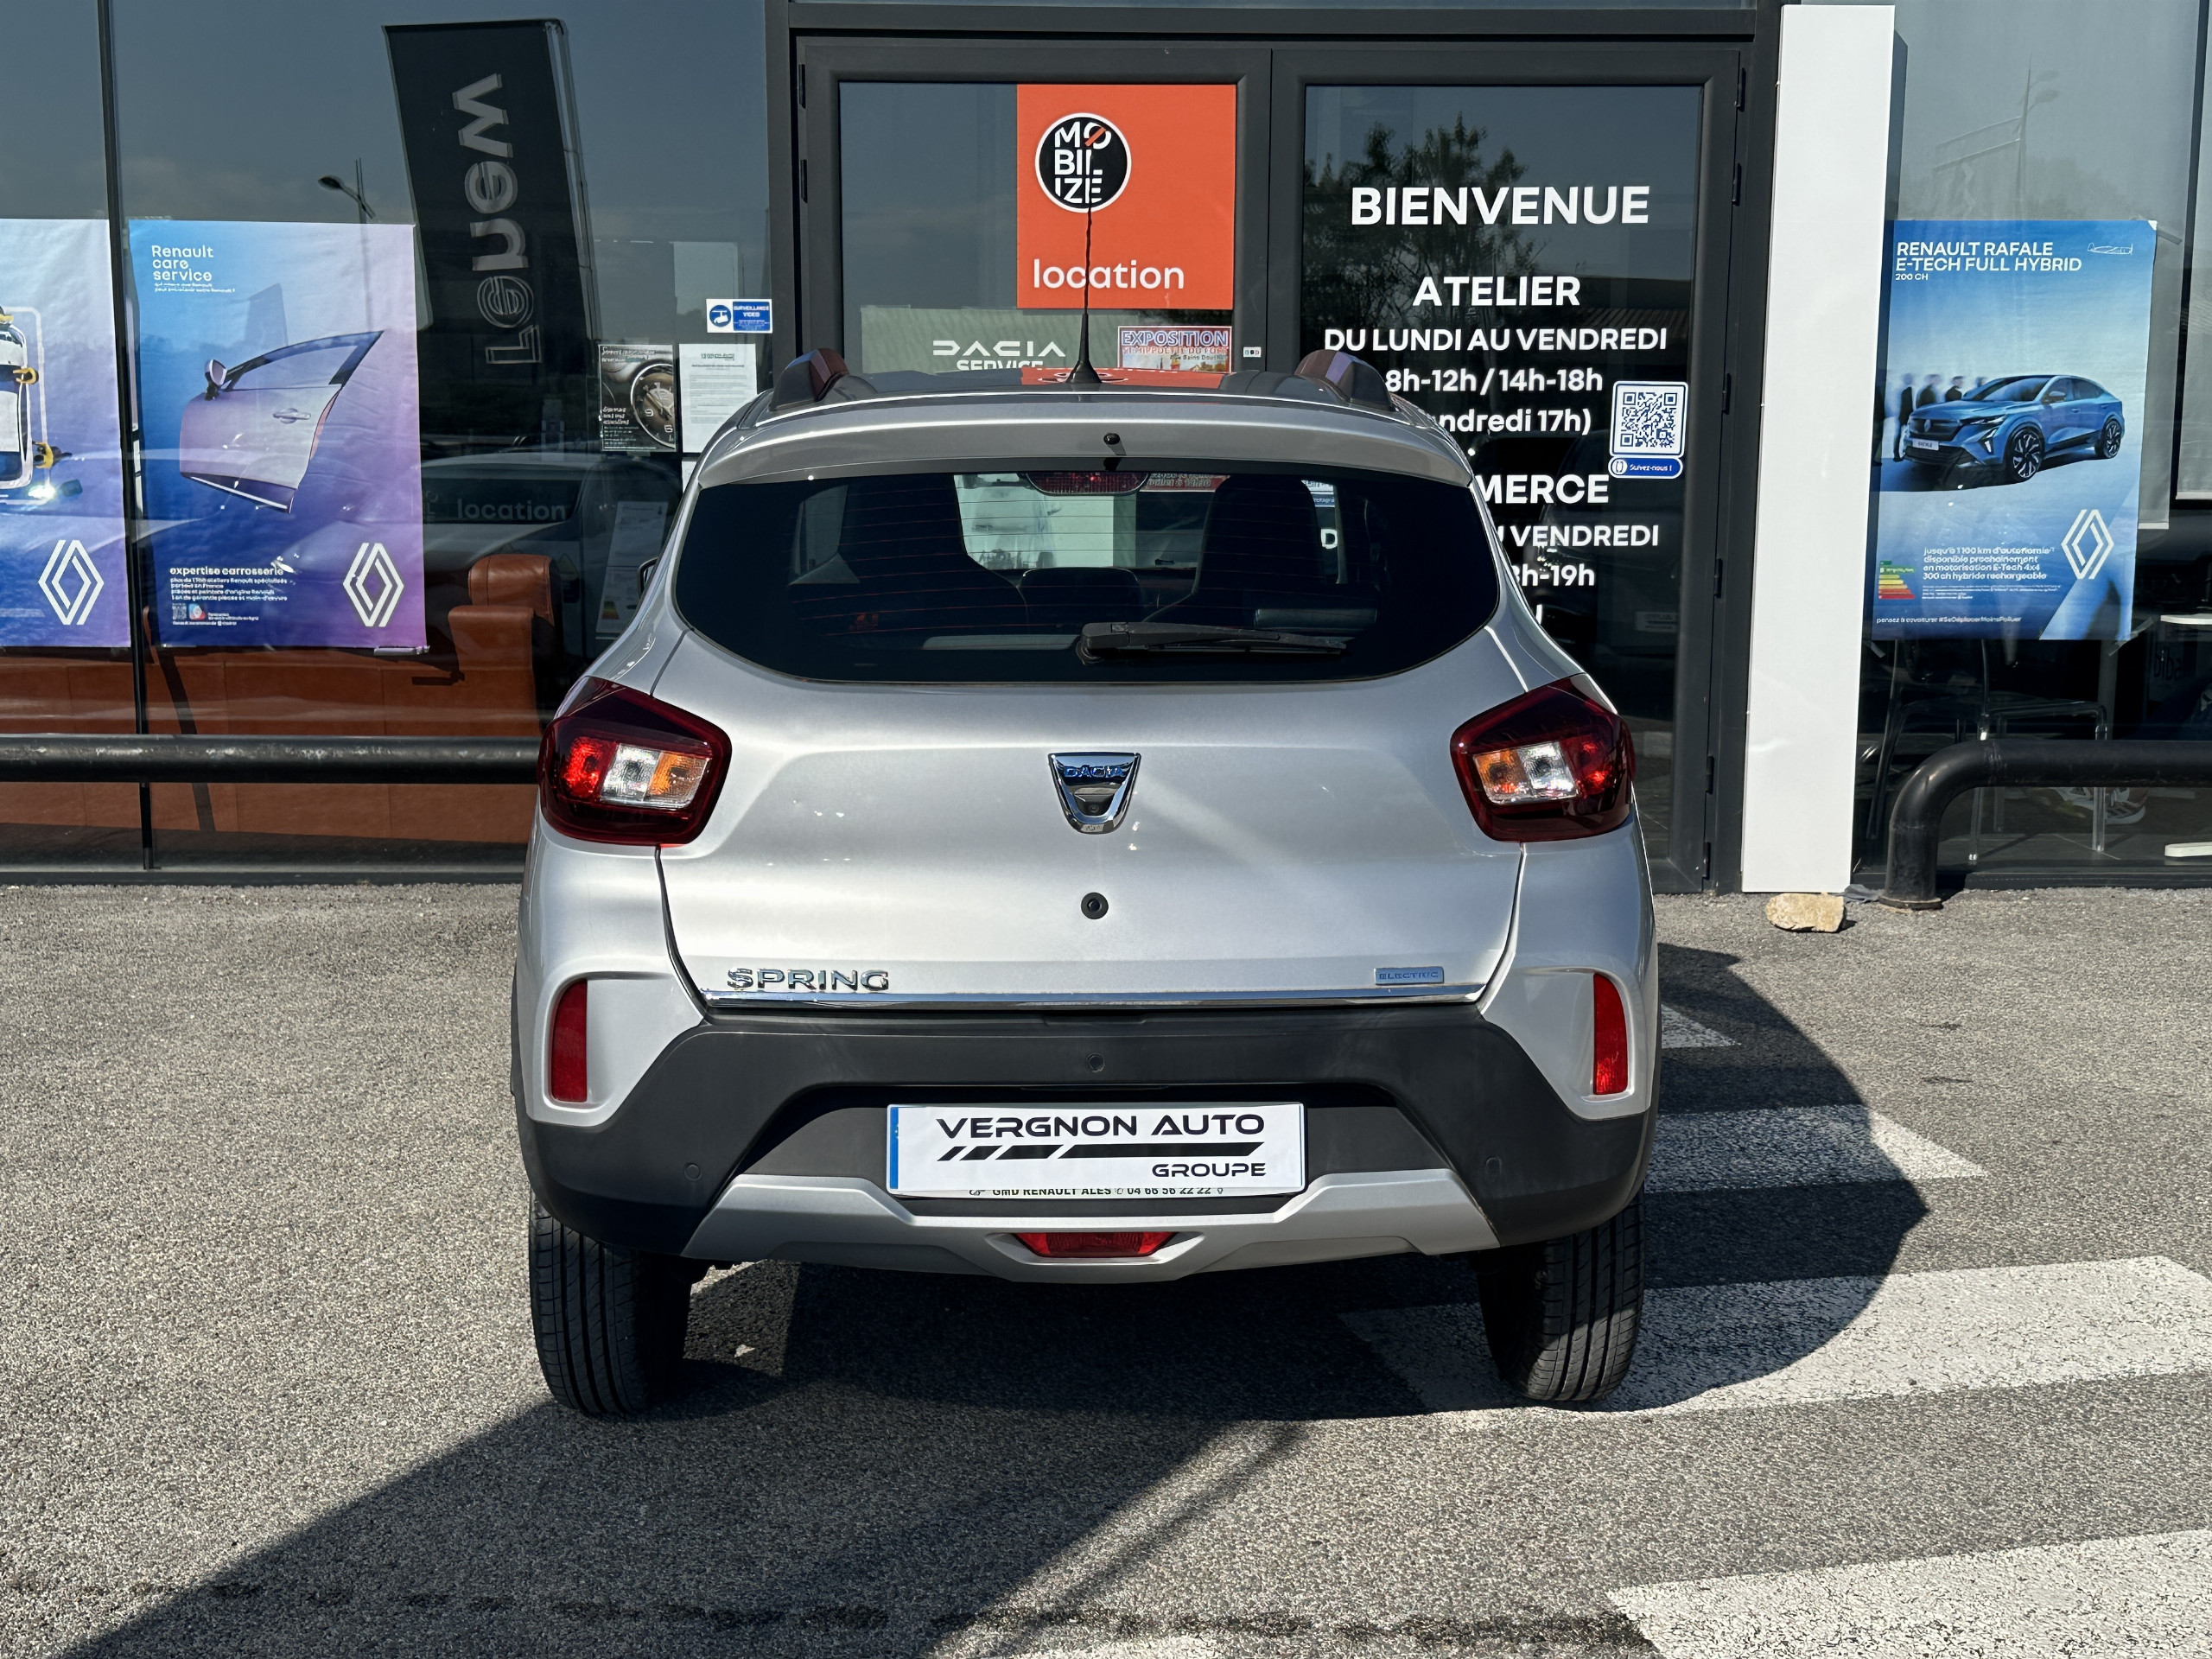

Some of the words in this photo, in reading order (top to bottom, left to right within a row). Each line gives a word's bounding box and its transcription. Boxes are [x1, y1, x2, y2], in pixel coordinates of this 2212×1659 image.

[1351, 186, 1650, 226] BIENVENUE
[151, 245, 213, 257] Renault
[1897, 241, 1980, 256] RENAULT
[1984, 241, 2053, 256] RAFALE
[152, 258, 188, 269] care
[1895, 257, 1961, 271] E-TECH
[1965, 257, 2011, 271] FULL
[2015, 257, 2082, 271] HYBRID
[153, 269, 212, 281] service
[1033, 258, 1185, 289] location
[1412, 276, 1581, 307] ATELIER
[1121, 330, 1229, 346] EXPOSITION
[1325, 328, 1366, 351] DU
[1372, 328, 1461, 351] LUNDI
[1468, 328, 1510, 351] AU
[1516, 327, 1668, 350] VENDREDI
[932, 340, 1066, 358] DACIA
[1385, 368, 1477, 392] 8h-12h
[1499, 368, 1604, 392] 14h-18h
[1433, 409, 1531, 433] ndredi
[1537, 409, 1592, 435] 17h)
[1475, 474, 1610, 505] MERCE
[1510, 524, 1660, 547] VENDREDI
[169, 566, 220, 576] expertise
[1064, 766, 1126, 778] DACIA
[727, 968, 890, 992] SPRING
[1379, 971, 1439, 980] ELECTRIC
[936, 1115, 1138, 1139] VERGNON
[1150, 1113, 1265, 1136] AUTO
[1151, 1162, 1267, 1178] GROUPE
